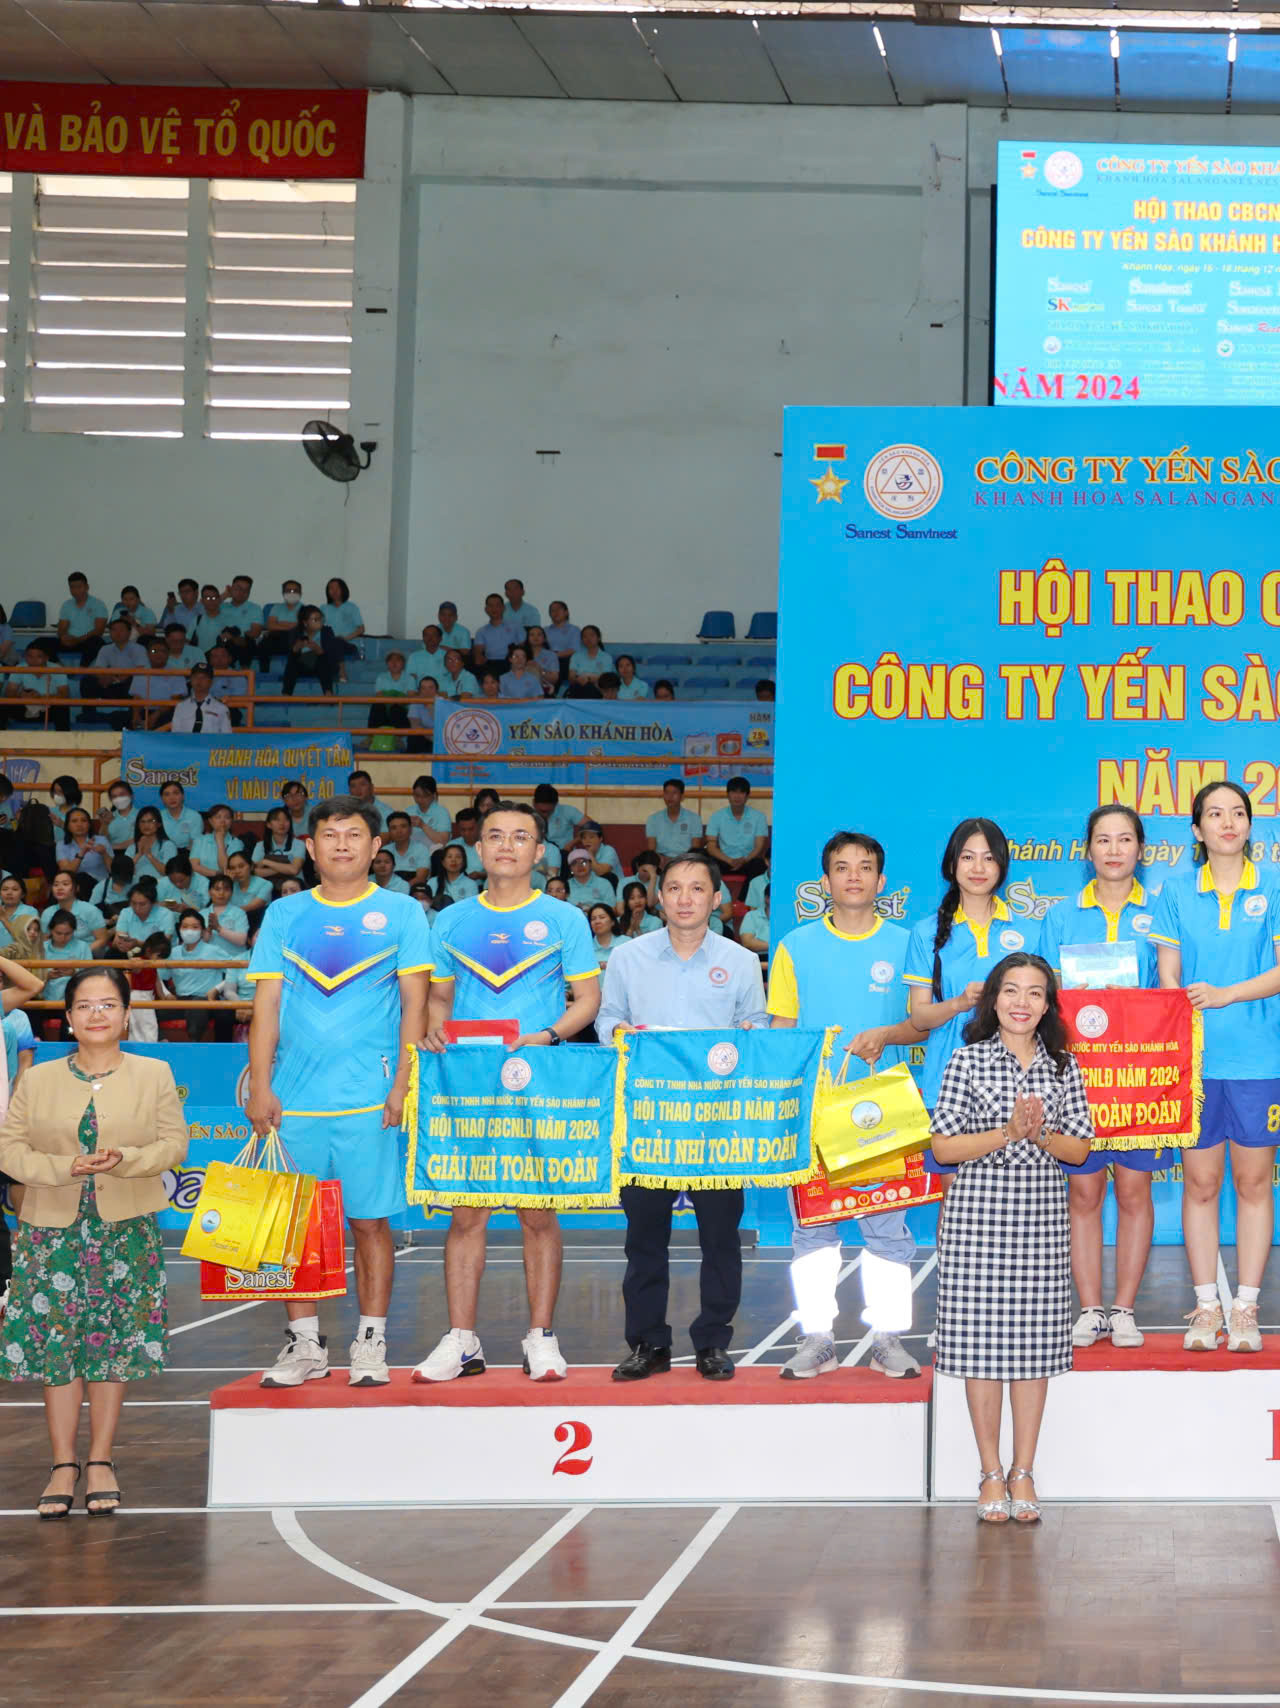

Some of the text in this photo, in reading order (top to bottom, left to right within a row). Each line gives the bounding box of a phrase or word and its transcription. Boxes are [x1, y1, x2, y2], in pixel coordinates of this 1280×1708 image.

[4, 99, 336, 164] VÀ BẢO VỆ TỔ QUỐC
[1134, 197, 1166, 222] HỘI
[1172, 201, 1222, 221] THAO
[1021, 225, 1076, 249] CÔNG
[1083, 230, 1104, 249] TY
[1110, 226, 1148, 250] YẾN
[1155, 228, 1193, 251] SÀO
[1200, 230, 1266, 252] KHÁNH
[1075, 374, 1140, 400] 2024
[975, 450, 1075, 484] CÔNG
[1083, 457, 1131, 483] TY
[1138, 446, 1213, 484] YẾN
[975, 491, 1063, 506] KHANH
[1073, 491, 1125, 506] HOA
[845, 523, 892, 539] Sanest
[999, 558, 1090, 637] HỘI
[1105, 570, 1244, 626] THAO
[833, 652, 985, 720] CÔNG
[999, 664, 1064, 720] TY
[1078, 646, 1186, 721] YẾN
[509, 717, 674, 742] YẾN SÀO KHÁNH HÒA
[208, 743, 351, 767] KHÁNH HÒA QUYẾT TÂM
[126, 757, 200, 786] Sanest
[1007, 838, 1062, 861] hánh
[1142, 840, 1184, 866] gày
[1092, 1042, 1107, 1053] MTV
[1109, 1041, 1123, 1053] YẾN
[1125, 1041, 1138, 1053] SÀO
[1140, 1041, 1164, 1053] KHÁNH
[1166, 1041, 1179, 1052] HÒA
[1081, 1064, 1180, 1088] CNLĐ NĂM 2024
[633, 1097, 799, 1126] HỘI THAO CBCNLĐ NĂM 2024
[1088, 1094, 1181, 1128] TOÀN ĐOÀN
[1267, 1103, 1280, 1133] 8
[188, 1121, 247, 1139] ẾN SÀO
[429, 1113, 452, 1142] HỘI
[454, 1118, 485, 1138] THAO
[536, 1116, 567, 1140] NĂM
[568, 1120, 599, 1140] 2024
[631, 1129, 798, 1164] GIẢI NHÌ TOÀN ĐOÀN
[427, 1146, 599, 1183] GIẢI NHÌ TOÀN ĐOÀN
[225, 1266, 296, 1291] Sanest
[552, 1421, 593, 1475] 2
